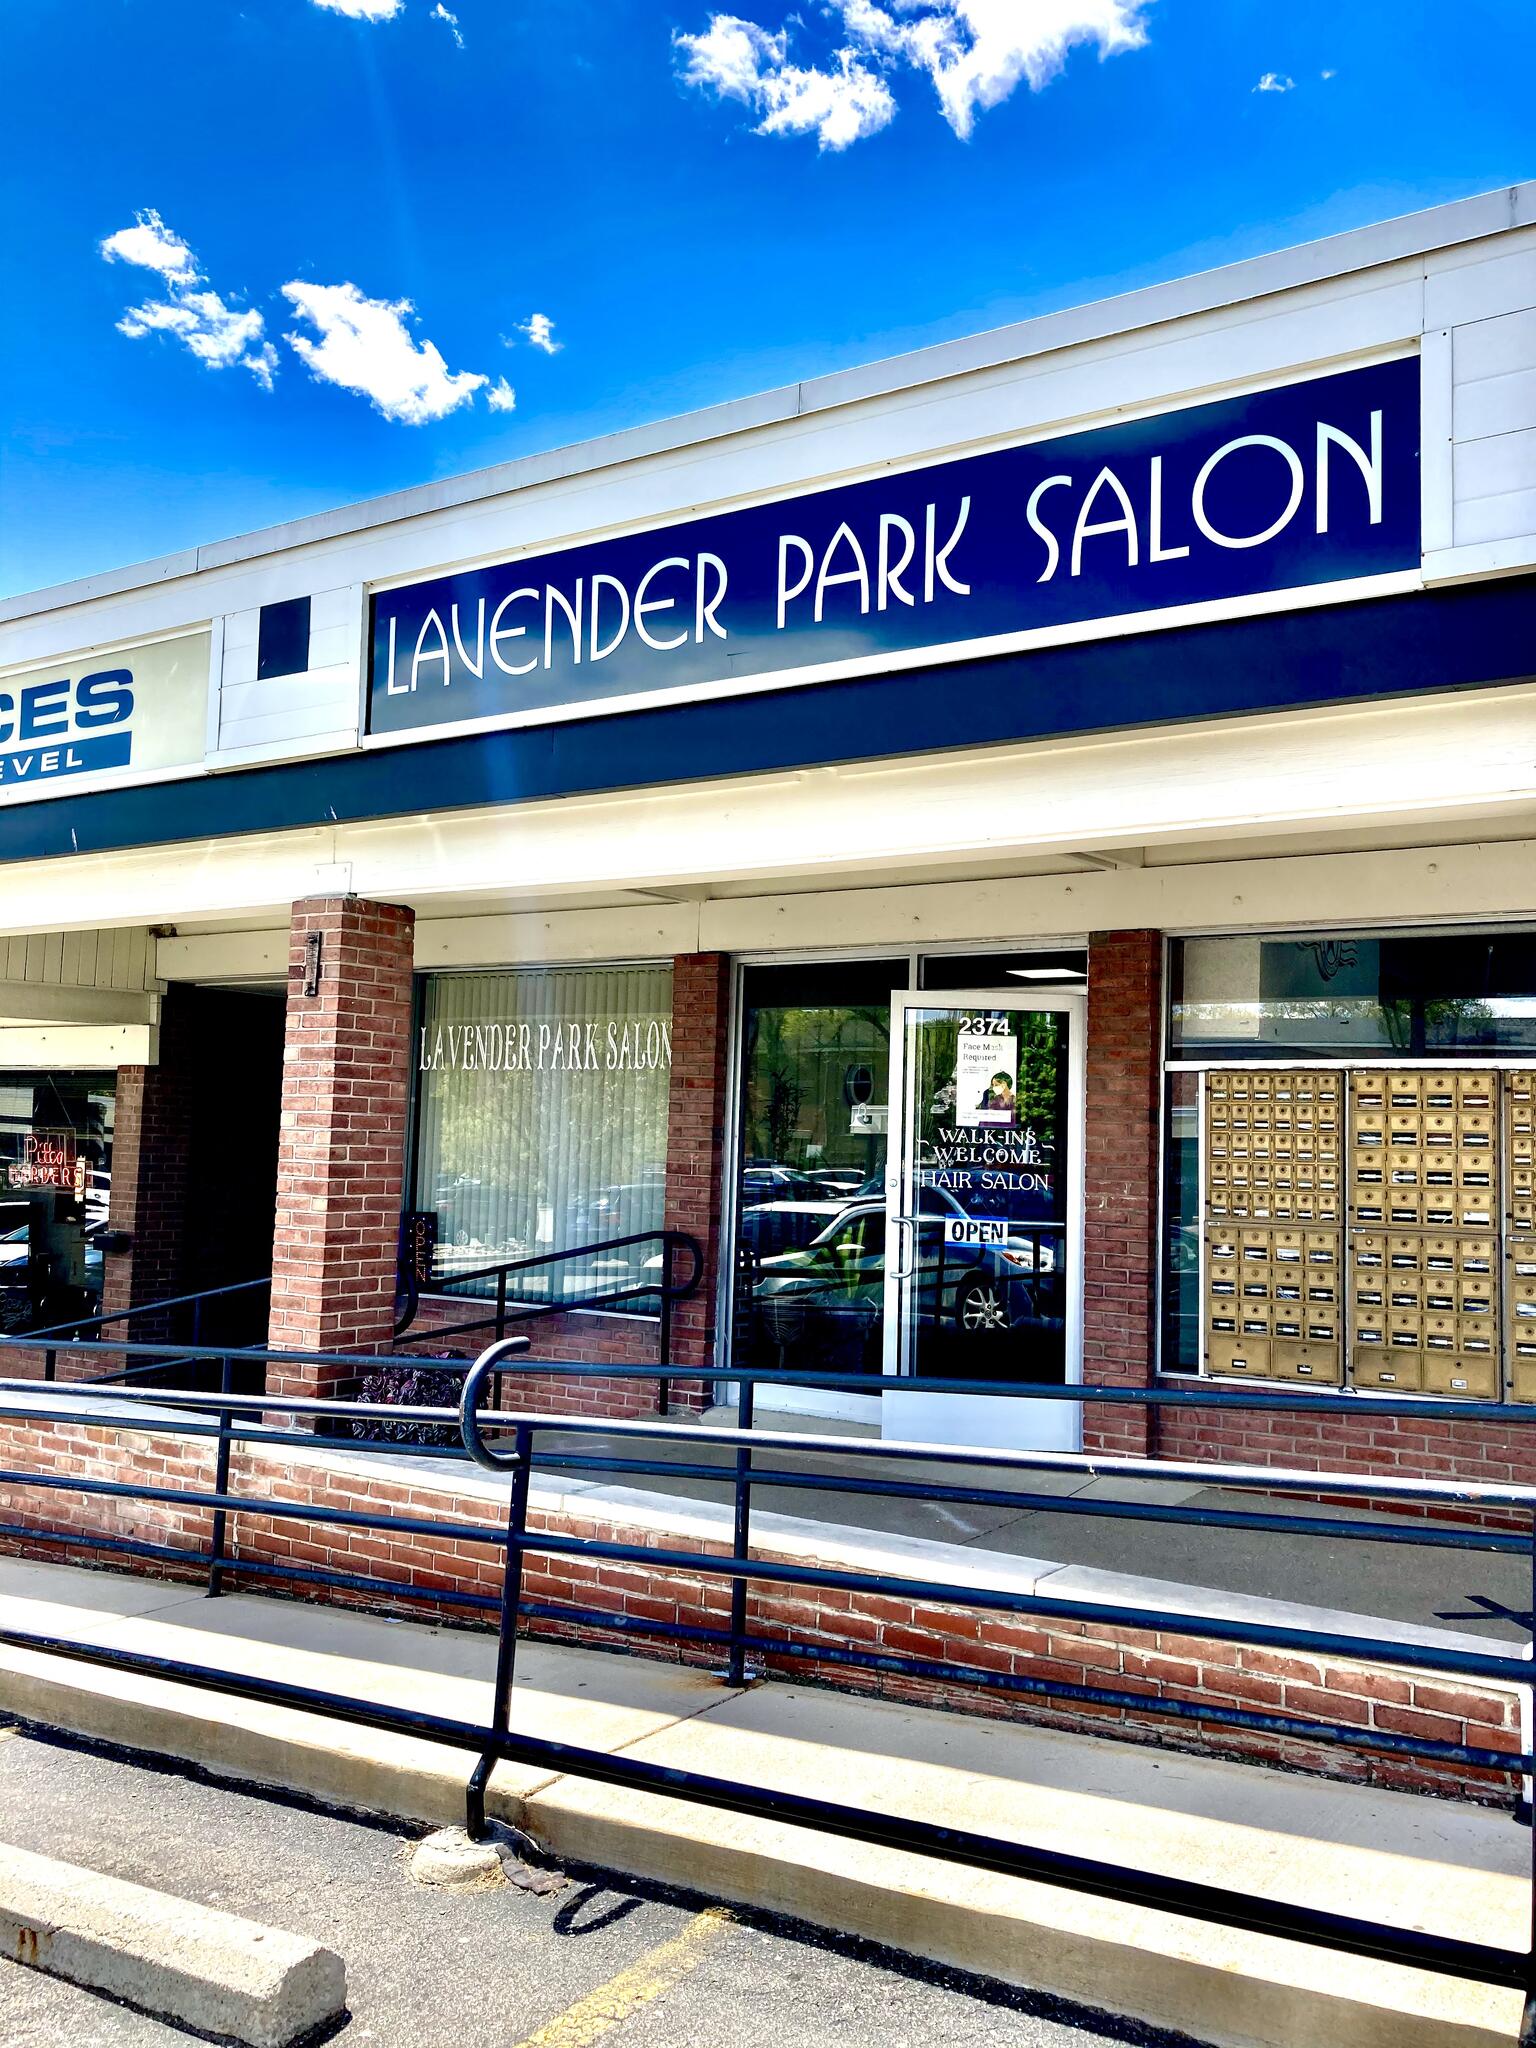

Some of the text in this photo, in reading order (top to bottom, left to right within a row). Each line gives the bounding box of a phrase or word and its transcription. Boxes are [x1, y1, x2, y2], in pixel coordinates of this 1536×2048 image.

[387, 410, 1382, 696] LAVENDER PARK SALON
[0, 668, 134, 743] ES
[0, 749, 83, 779] VEL
[959, 1017, 1011, 1035] 2374
[419, 1021, 672, 1071] LAVENDER PARK SALON
[963, 1043, 981, 1051] Face
[963, 1053, 997, 1062] Required
[938, 1127, 1037, 1146] WALK-INS
[933, 1146, 1042, 1165] WELCOME
[920, 1171, 1049, 1191] HAIR SALON
[951, 1221, 1004, 1243] OPEN
